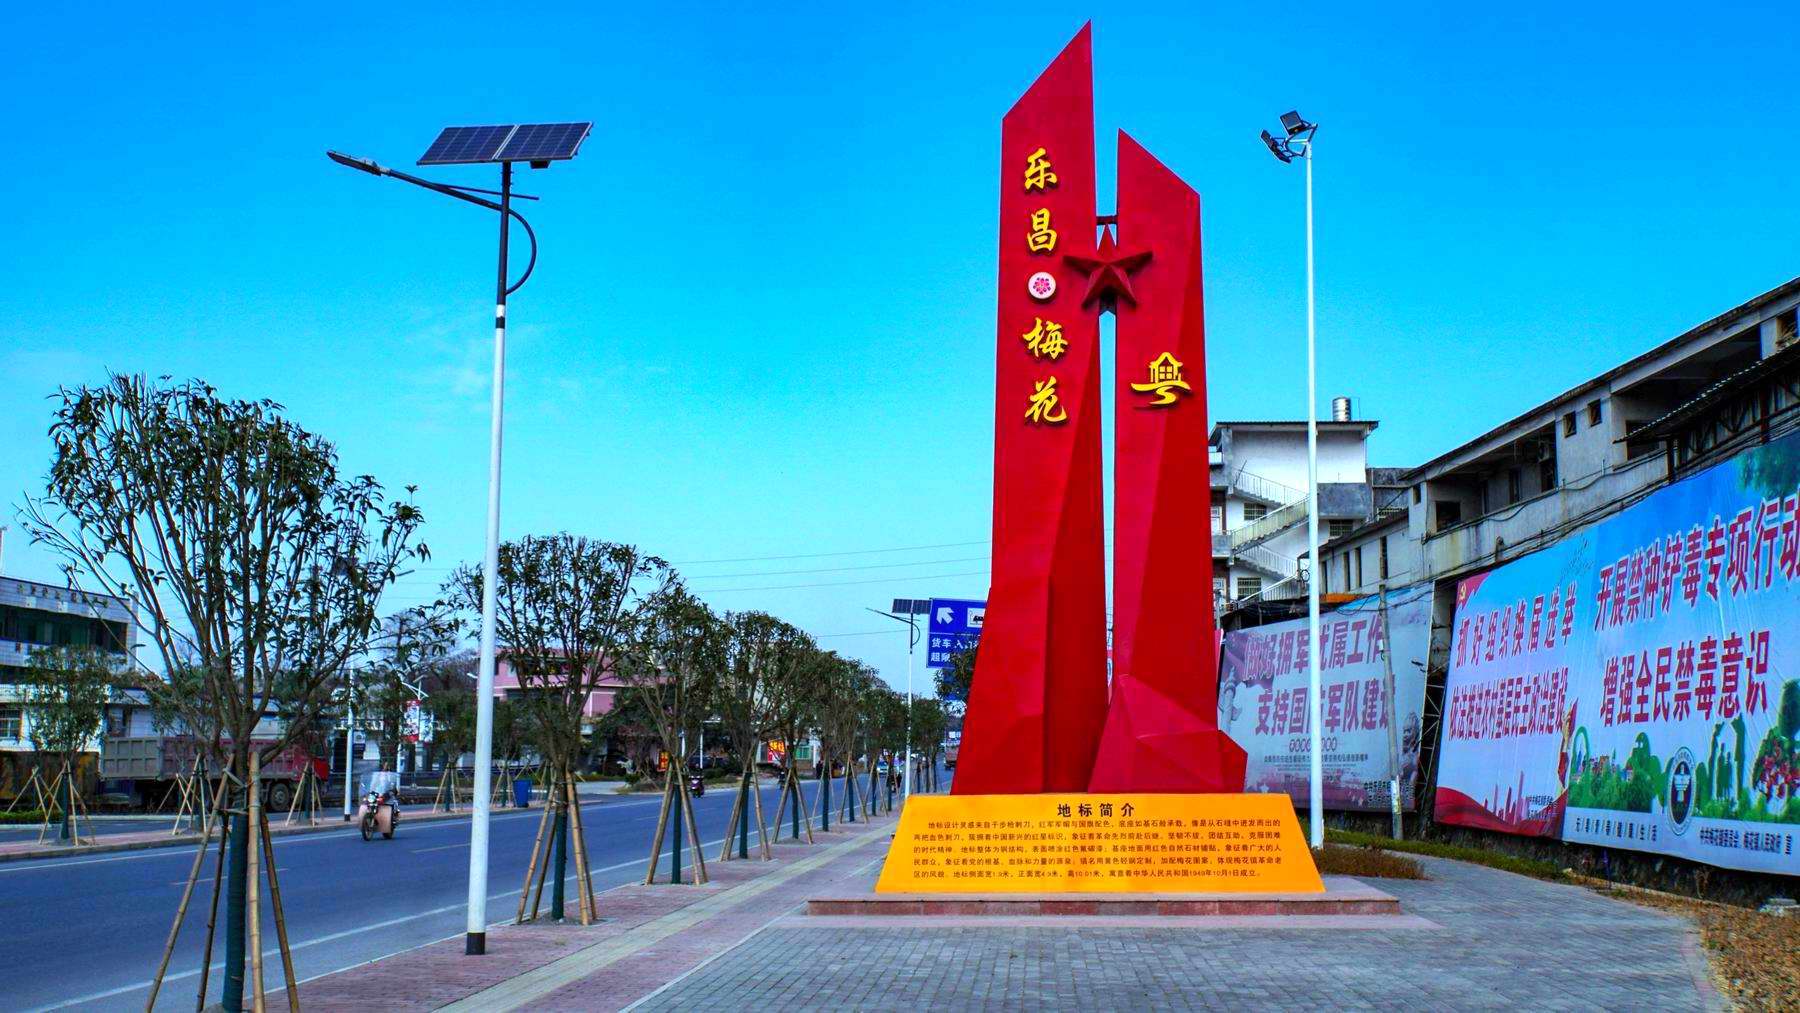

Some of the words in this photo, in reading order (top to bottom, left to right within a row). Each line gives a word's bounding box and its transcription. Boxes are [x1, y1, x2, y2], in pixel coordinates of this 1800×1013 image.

[1024, 147, 1059, 252] 乐昌
[1022, 316, 1069, 423] 梅花
[1594, 487, 1800, 633] 开展禁种铲毒专项行动
[1601, 629, 1771, 728] 增强全民禁毒意识
[1057, 802, 1135, 817] 地标简介
